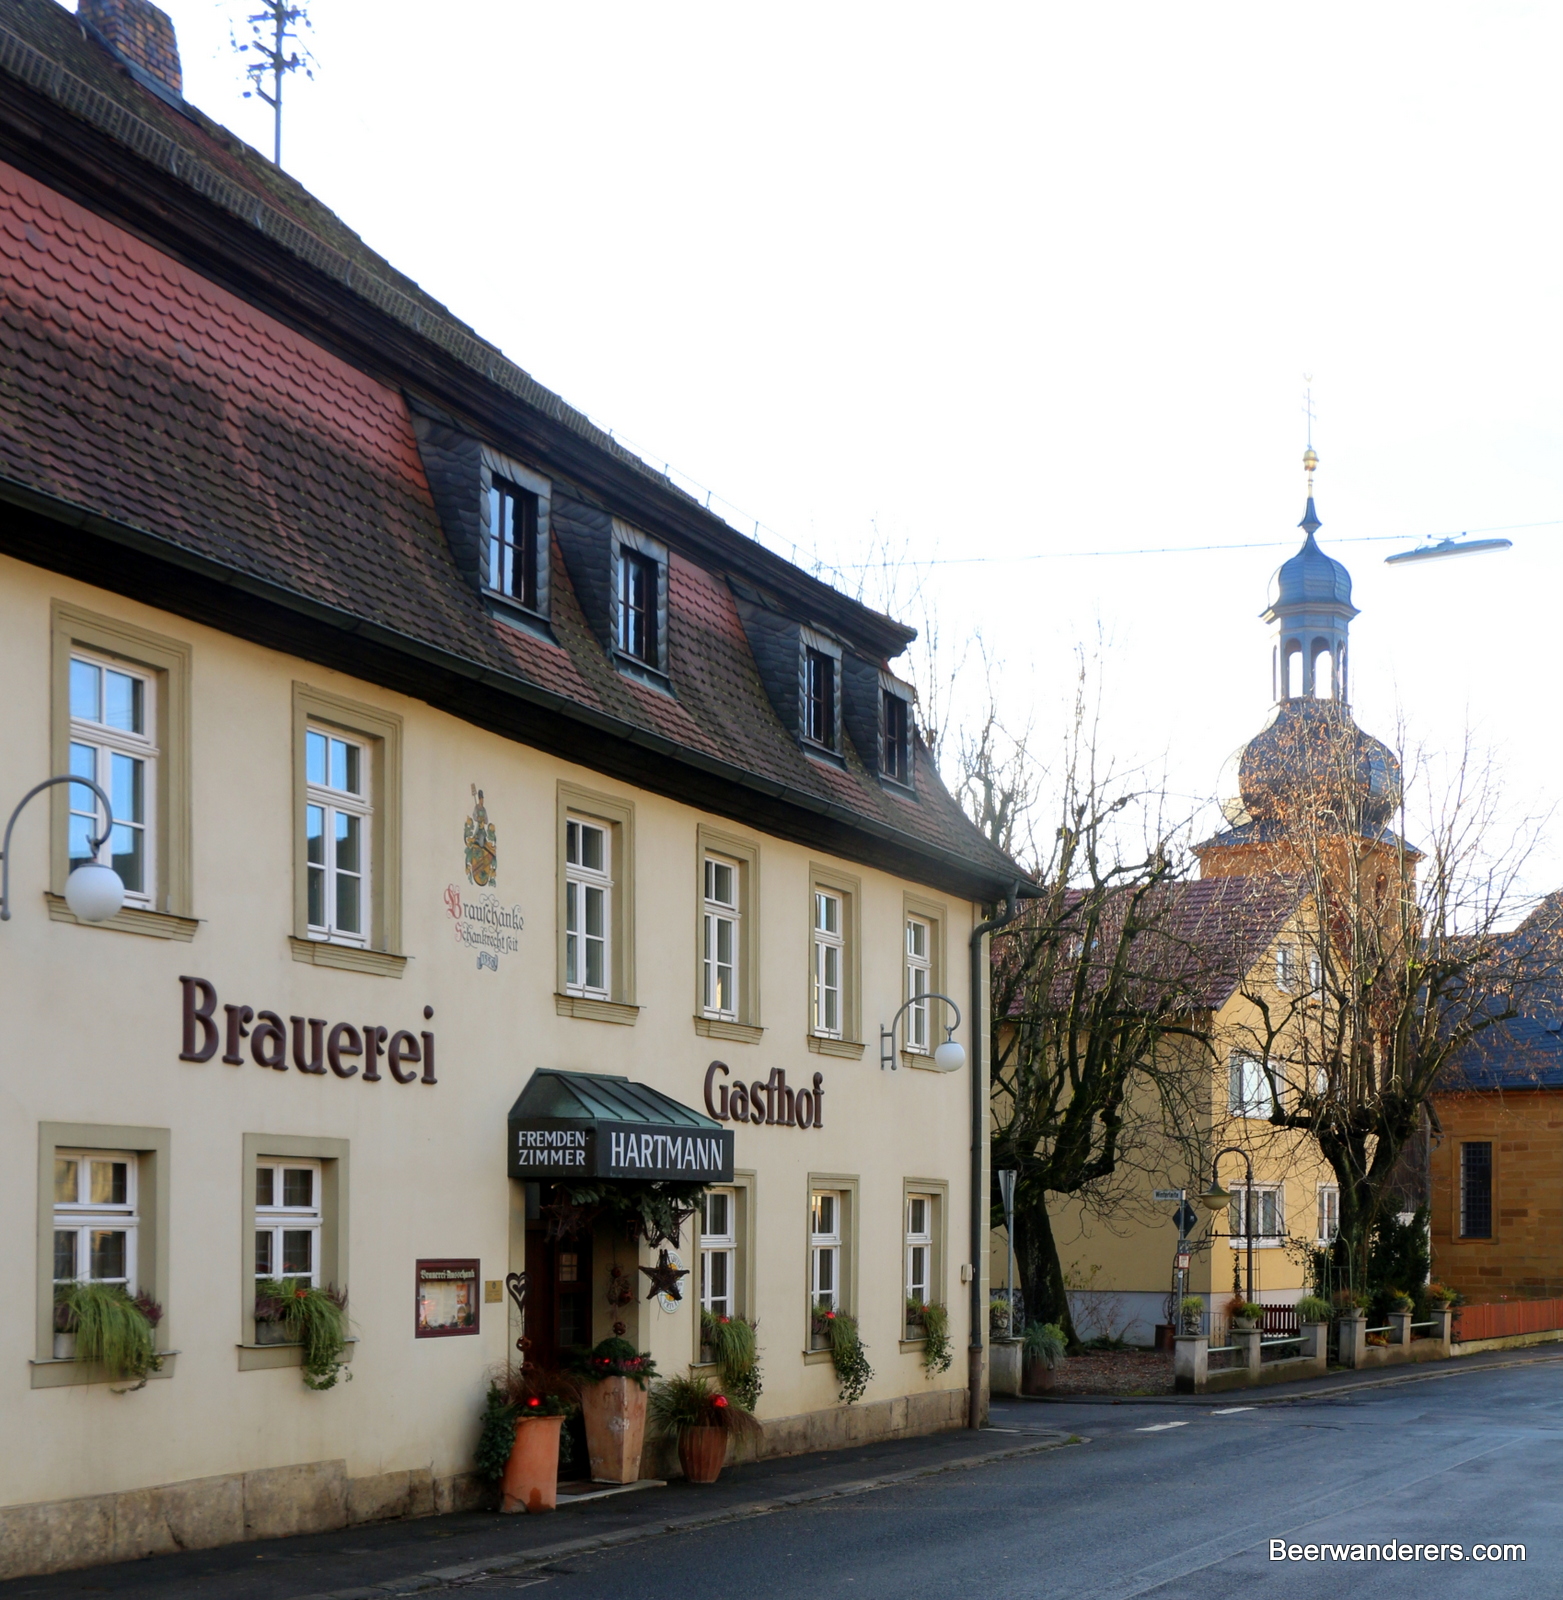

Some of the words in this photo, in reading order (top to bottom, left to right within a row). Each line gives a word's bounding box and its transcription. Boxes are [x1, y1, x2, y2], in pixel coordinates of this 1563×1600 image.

[179, 975, 438, 1084] Brauerei
[704, 1060, 824, 1129] Gasthof
[518, 1130, 590, 1147] FREMDEN-
[518, 1149, 586, 1166] ZIMMER
[611, 1131, 723, 1171] HARTMANN
